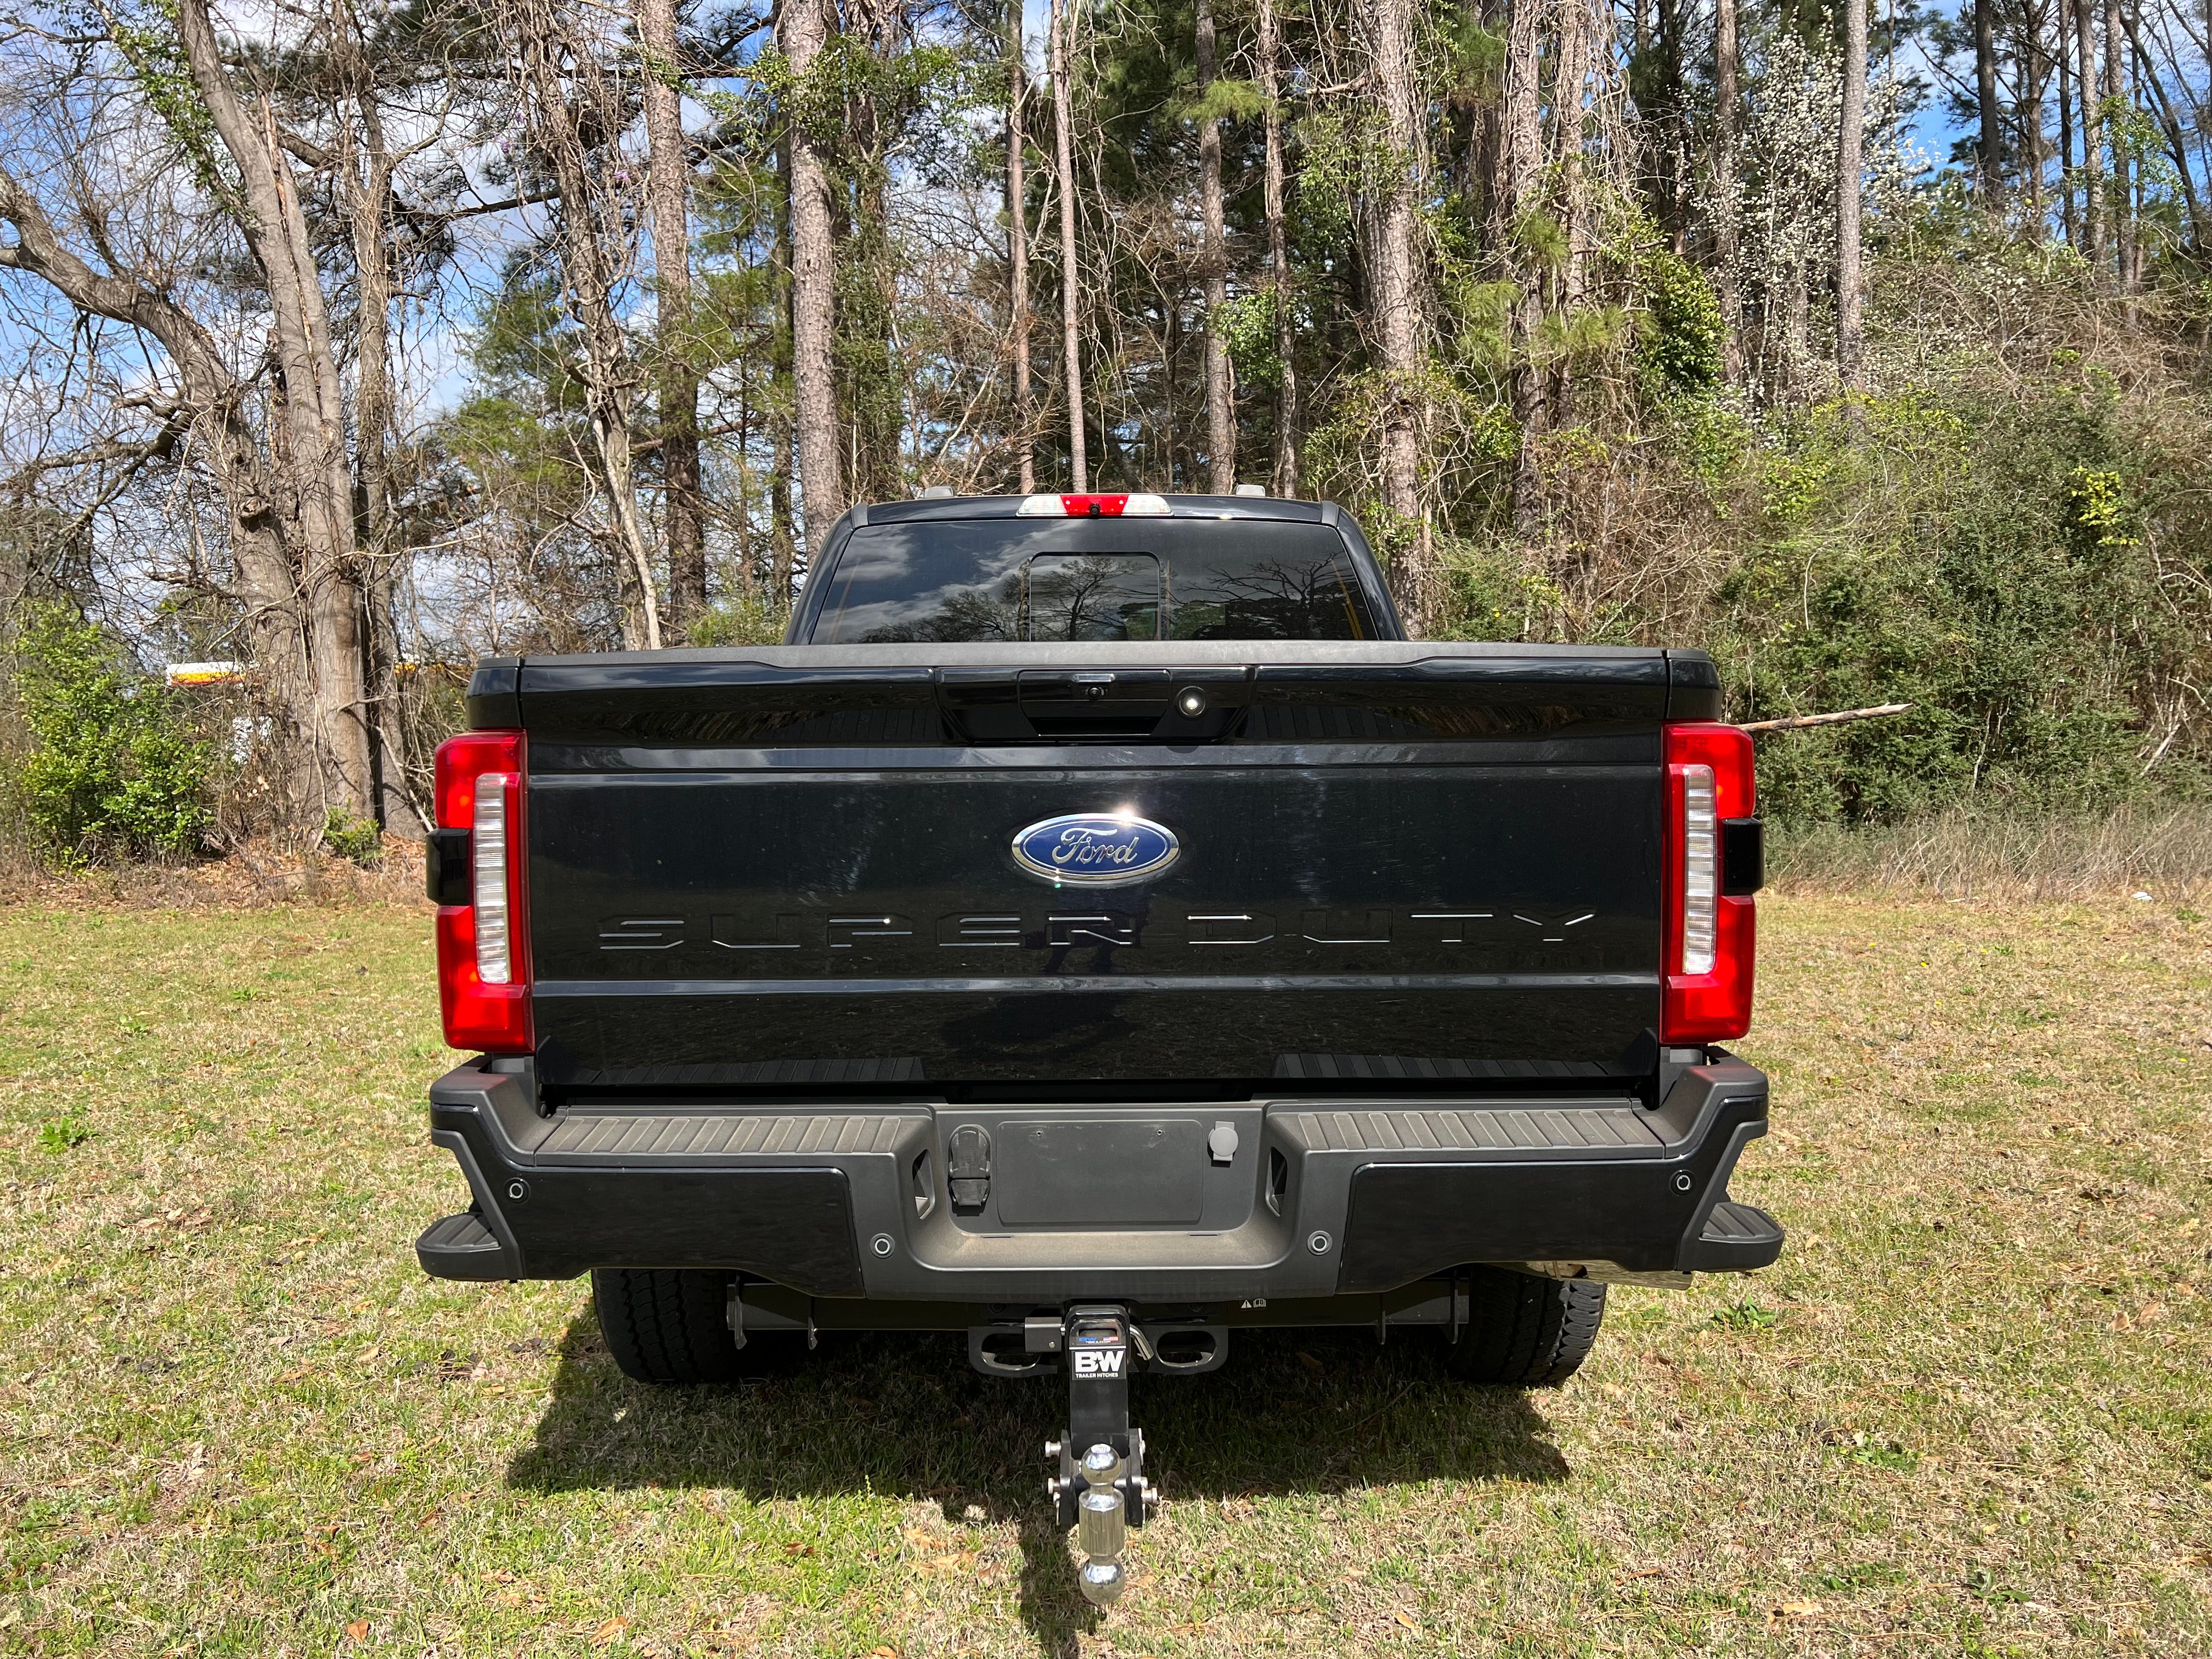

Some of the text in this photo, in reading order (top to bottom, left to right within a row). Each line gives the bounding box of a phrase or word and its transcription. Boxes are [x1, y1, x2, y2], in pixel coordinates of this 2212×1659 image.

[1051, 827, 1139, 865] Ford
[598, 907, 1598, 949] SUPER DUTY
